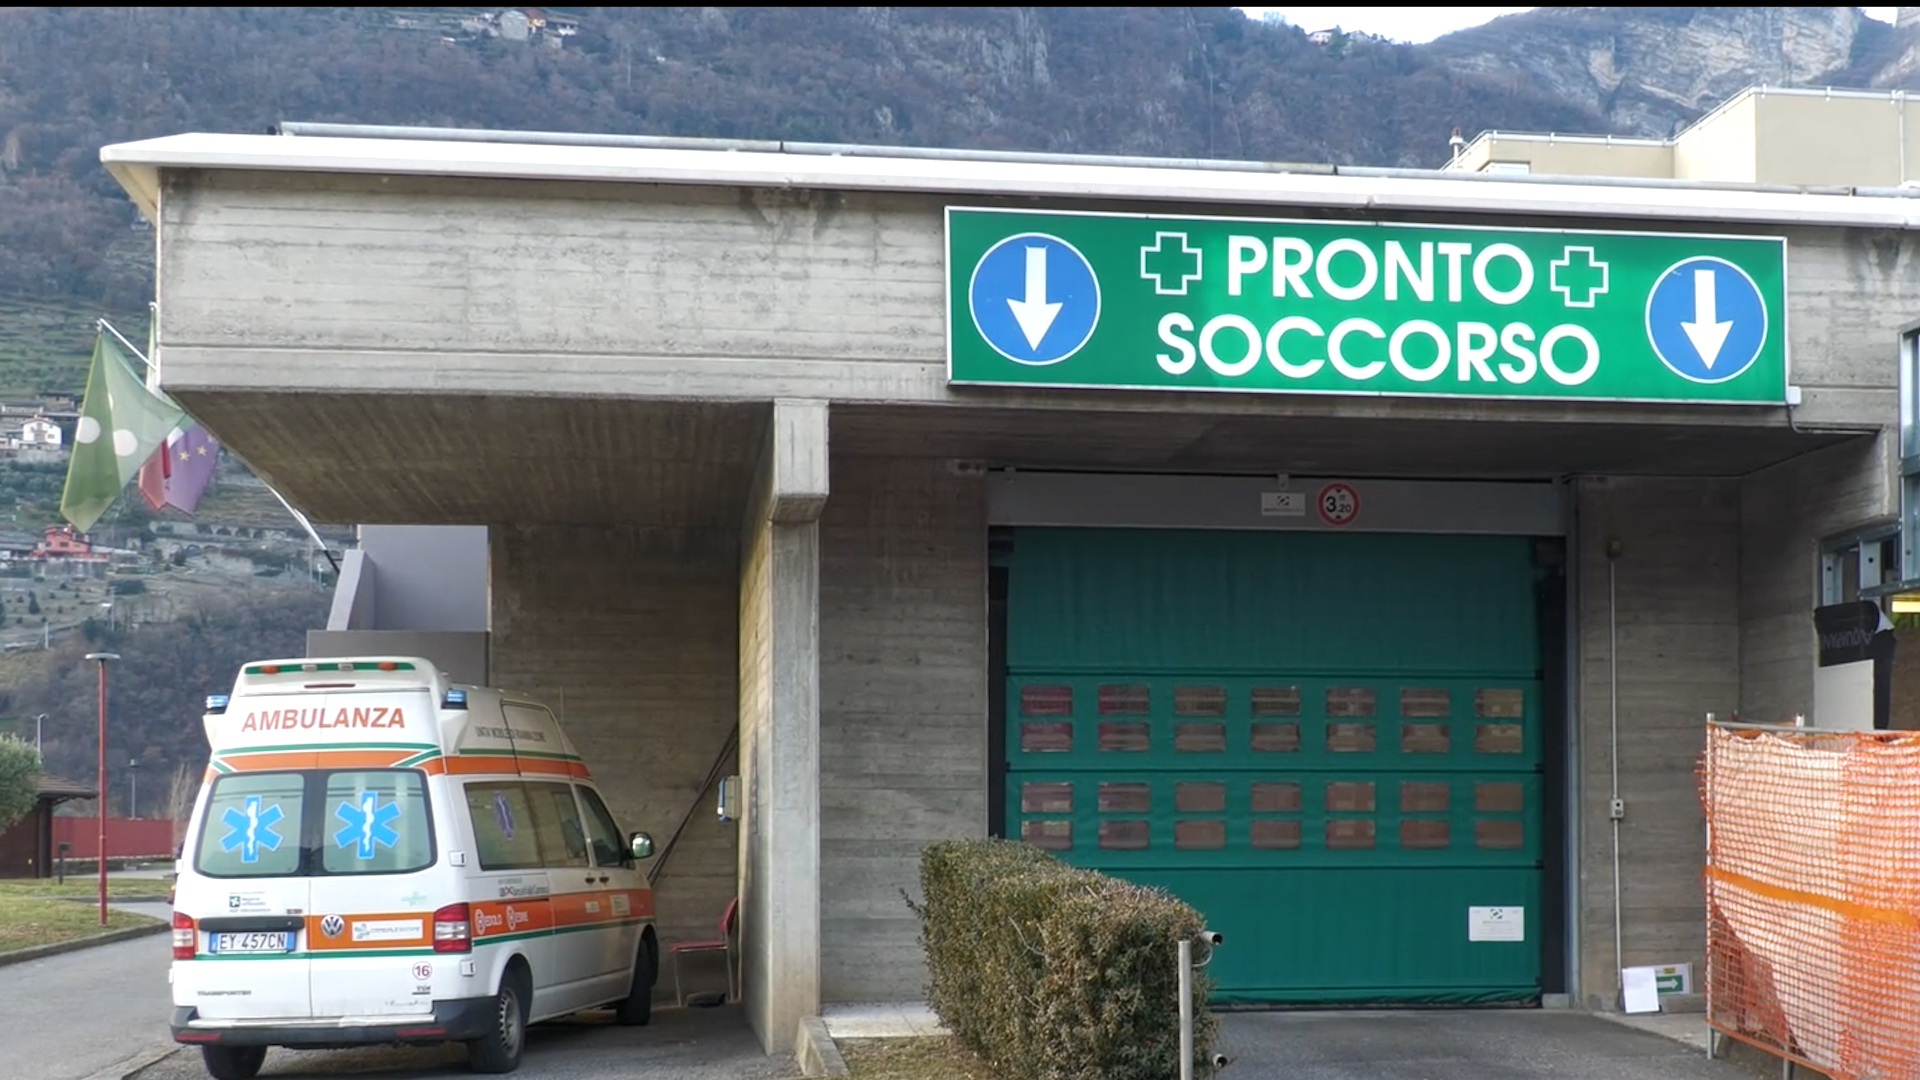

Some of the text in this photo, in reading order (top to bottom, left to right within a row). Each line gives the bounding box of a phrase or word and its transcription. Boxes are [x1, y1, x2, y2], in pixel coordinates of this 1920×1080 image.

[1227, 235, 1535, 306] PRONTO
[1155, 312, 1601, 386] SOCCORSO
[241, 707, 405, 732] AMBULANZA
[219, 932, 286, 949] EY 457CN
[415, 965, 430, 977] 16
